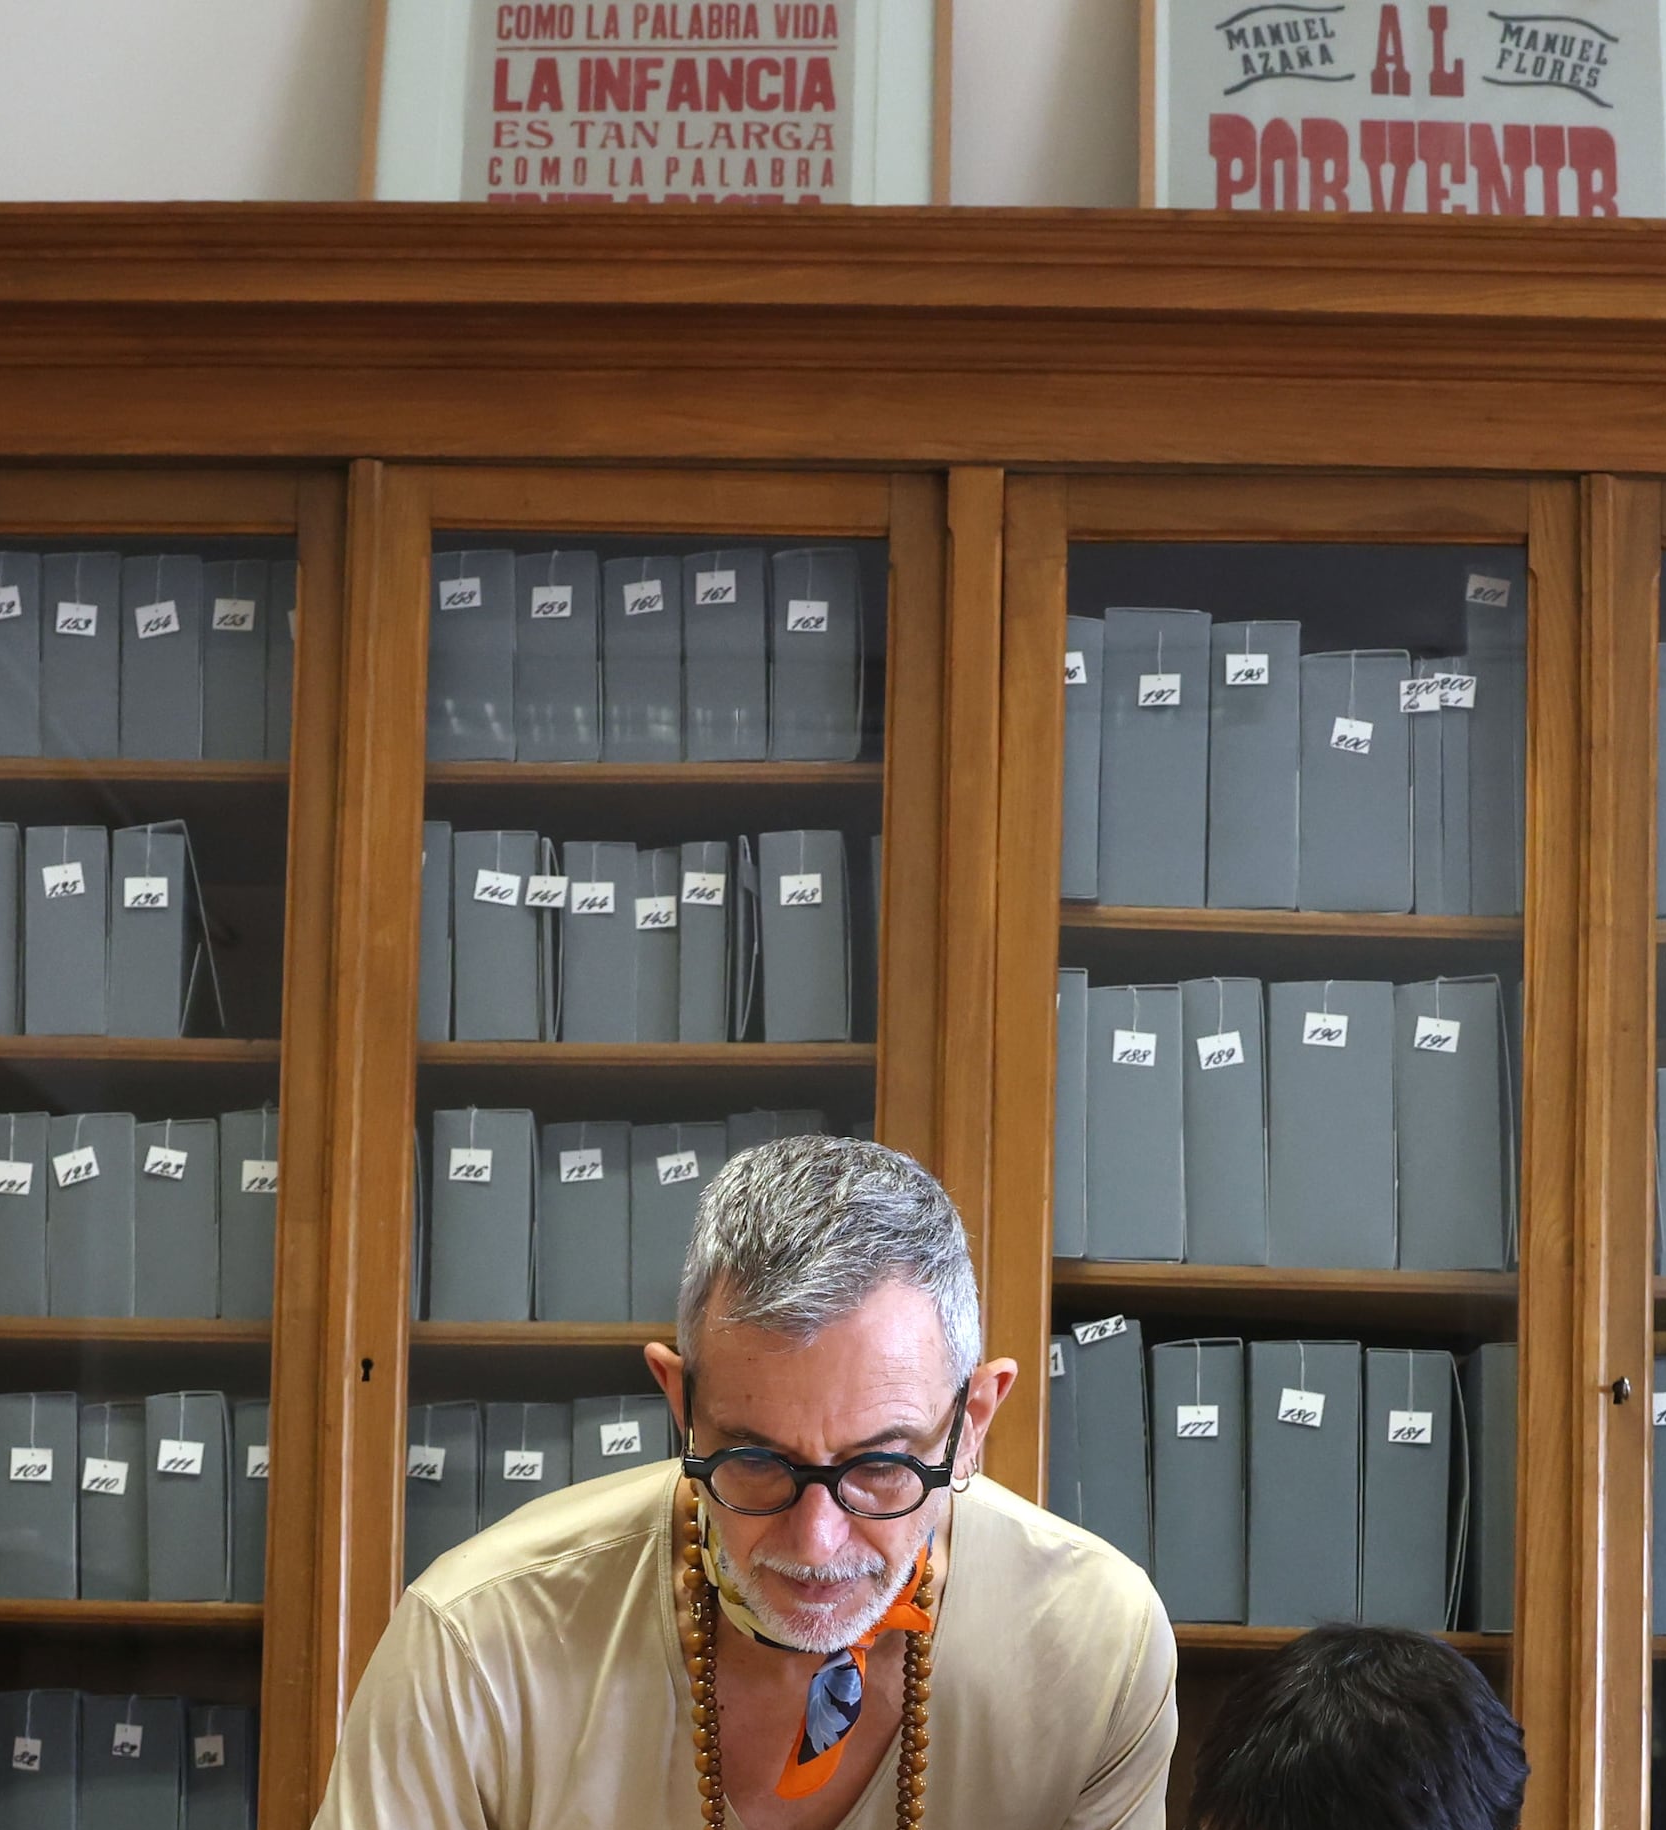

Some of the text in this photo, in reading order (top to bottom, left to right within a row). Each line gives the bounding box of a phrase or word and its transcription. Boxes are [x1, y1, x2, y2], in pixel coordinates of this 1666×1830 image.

[497, 3, 839, 40] COMO LA PALABRA VIDA
[1225, 17, 1335, 50] MANUEL
[1370, 3, 1465, 97] AL
[1499, 22, 1609, 66] MANUEL
[1242, 43, 1334, 76] AZAÑA
[1496, 47, 1602, 89] FLORES
[493, 57, 835, 112] LA INFANCIA
[493, 120, 834, 150] ES TAN LARGA
[488, 157, 834, 188] COMO LA PALABRA
[444, 590, 477, 606] 158
[700, 586, 733, 602] 161
[1469, 586, 1503, 602] 201
[534, 600, 568, 616] 159
[629, 593, 662, 612] 160
[59, 617, 93, 631] 153
[142, 615, 172, 634] 154
[216, 613, 250, 628] 155
[791, 616, 826, 630] 162
[1231, 668, 1265, 683] 198
[1141, 688, 1177, 704] 197
[1333, 734, 1369, 751] 200
[130, 892, 164, 906] 136
[477, 885, 514, 901] 140
[528, 889, 563, 904] 141
[685, 886, 721, 901] 146
[785, 887, 820, 904] 148
[576, 896, 608, 911] 144
[640, 910, 675, 926] 145
[1307, 1027, 1343, 1042] 190
[1418, 1033, 1452, 1049] 191
[1117, 1048, 1152, 1064] 188
[1204, 1047, 1236, 1067] 189
[62, 1161, 93, 1184] 122
[149, 1160, 185, 1176] 123
[454, 1163, 489, 1179] 126
[566, 1162, 600, 1180] 127
[663, 1164, 695, 1180] 128
[1282, 1408, 1317, 1424] 180
[1181, 1420, 1215, 1436] 177
[1392, 1426, 1426, 1441] 181
[606, 1435, 638, 1453] 116
[14, 1463, 48, 1478] 109
[163, 1457, 195, 1471] 111
[507, 1463, 539, 1477] 115
[86, 1476, 119, 1490] 110
